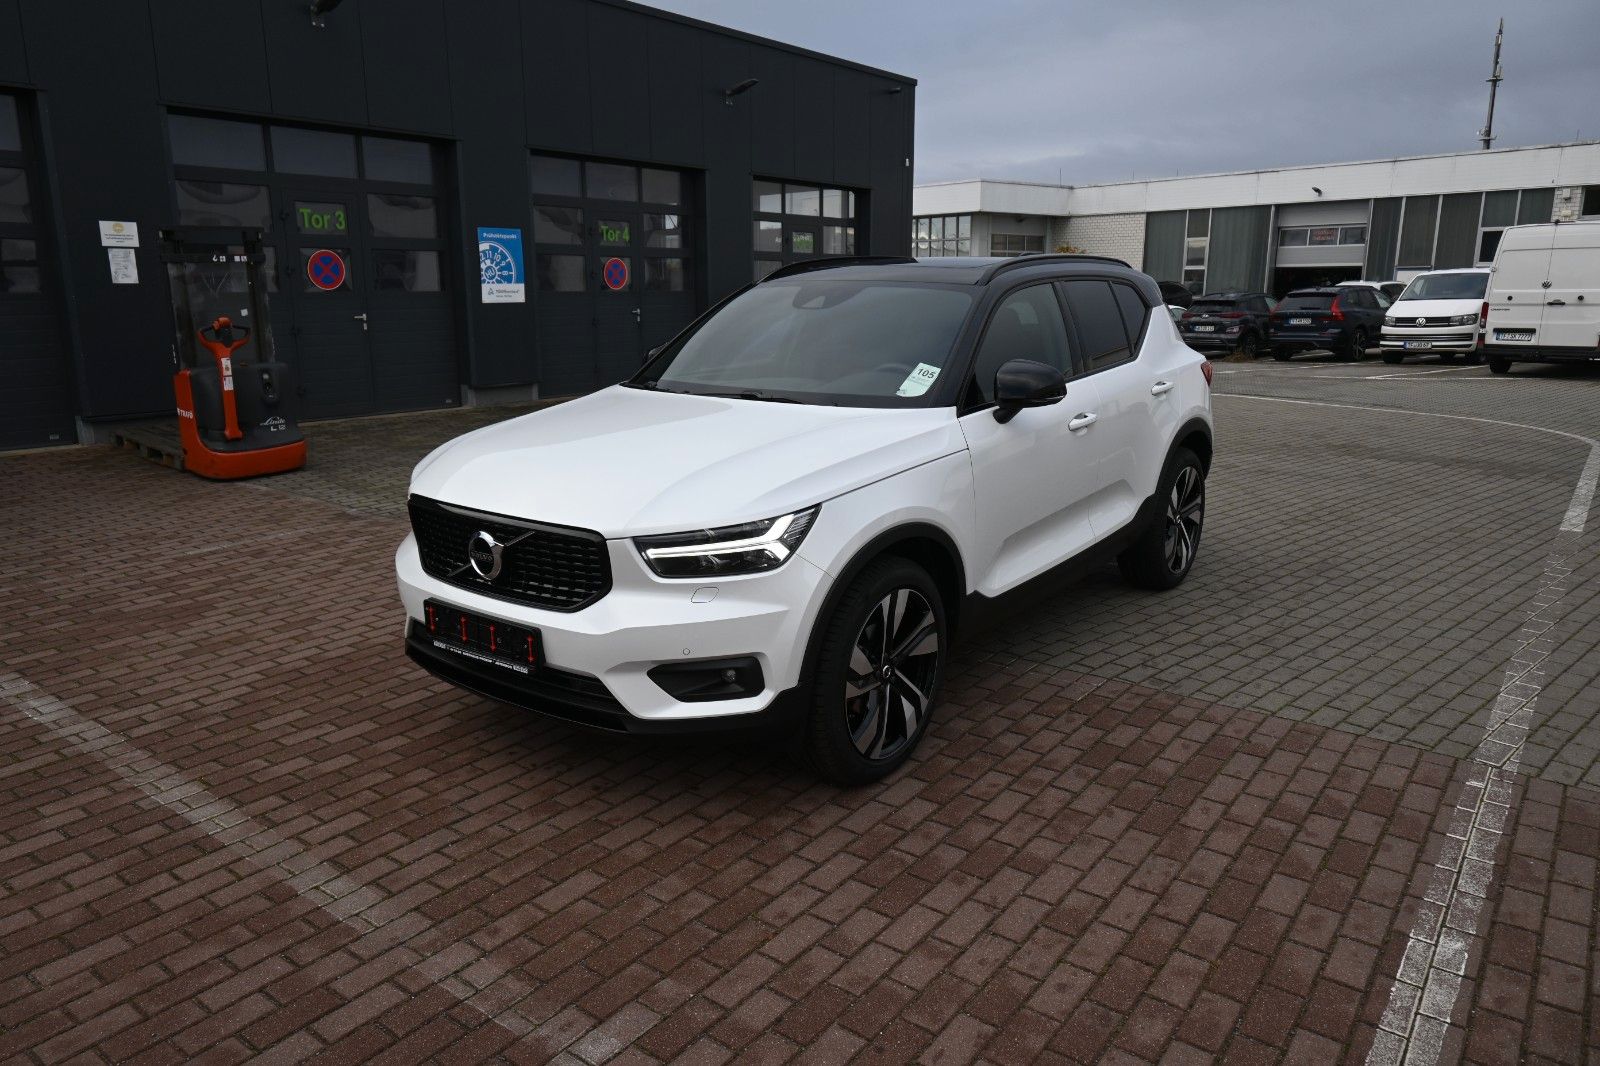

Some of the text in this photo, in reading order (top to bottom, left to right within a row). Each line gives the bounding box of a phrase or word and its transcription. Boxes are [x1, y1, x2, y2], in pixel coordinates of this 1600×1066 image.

[299, 208, 346, 230] Tor 3
[600, 225, 630, 242] Tor 4
[917, 369, 936, 379] 105
